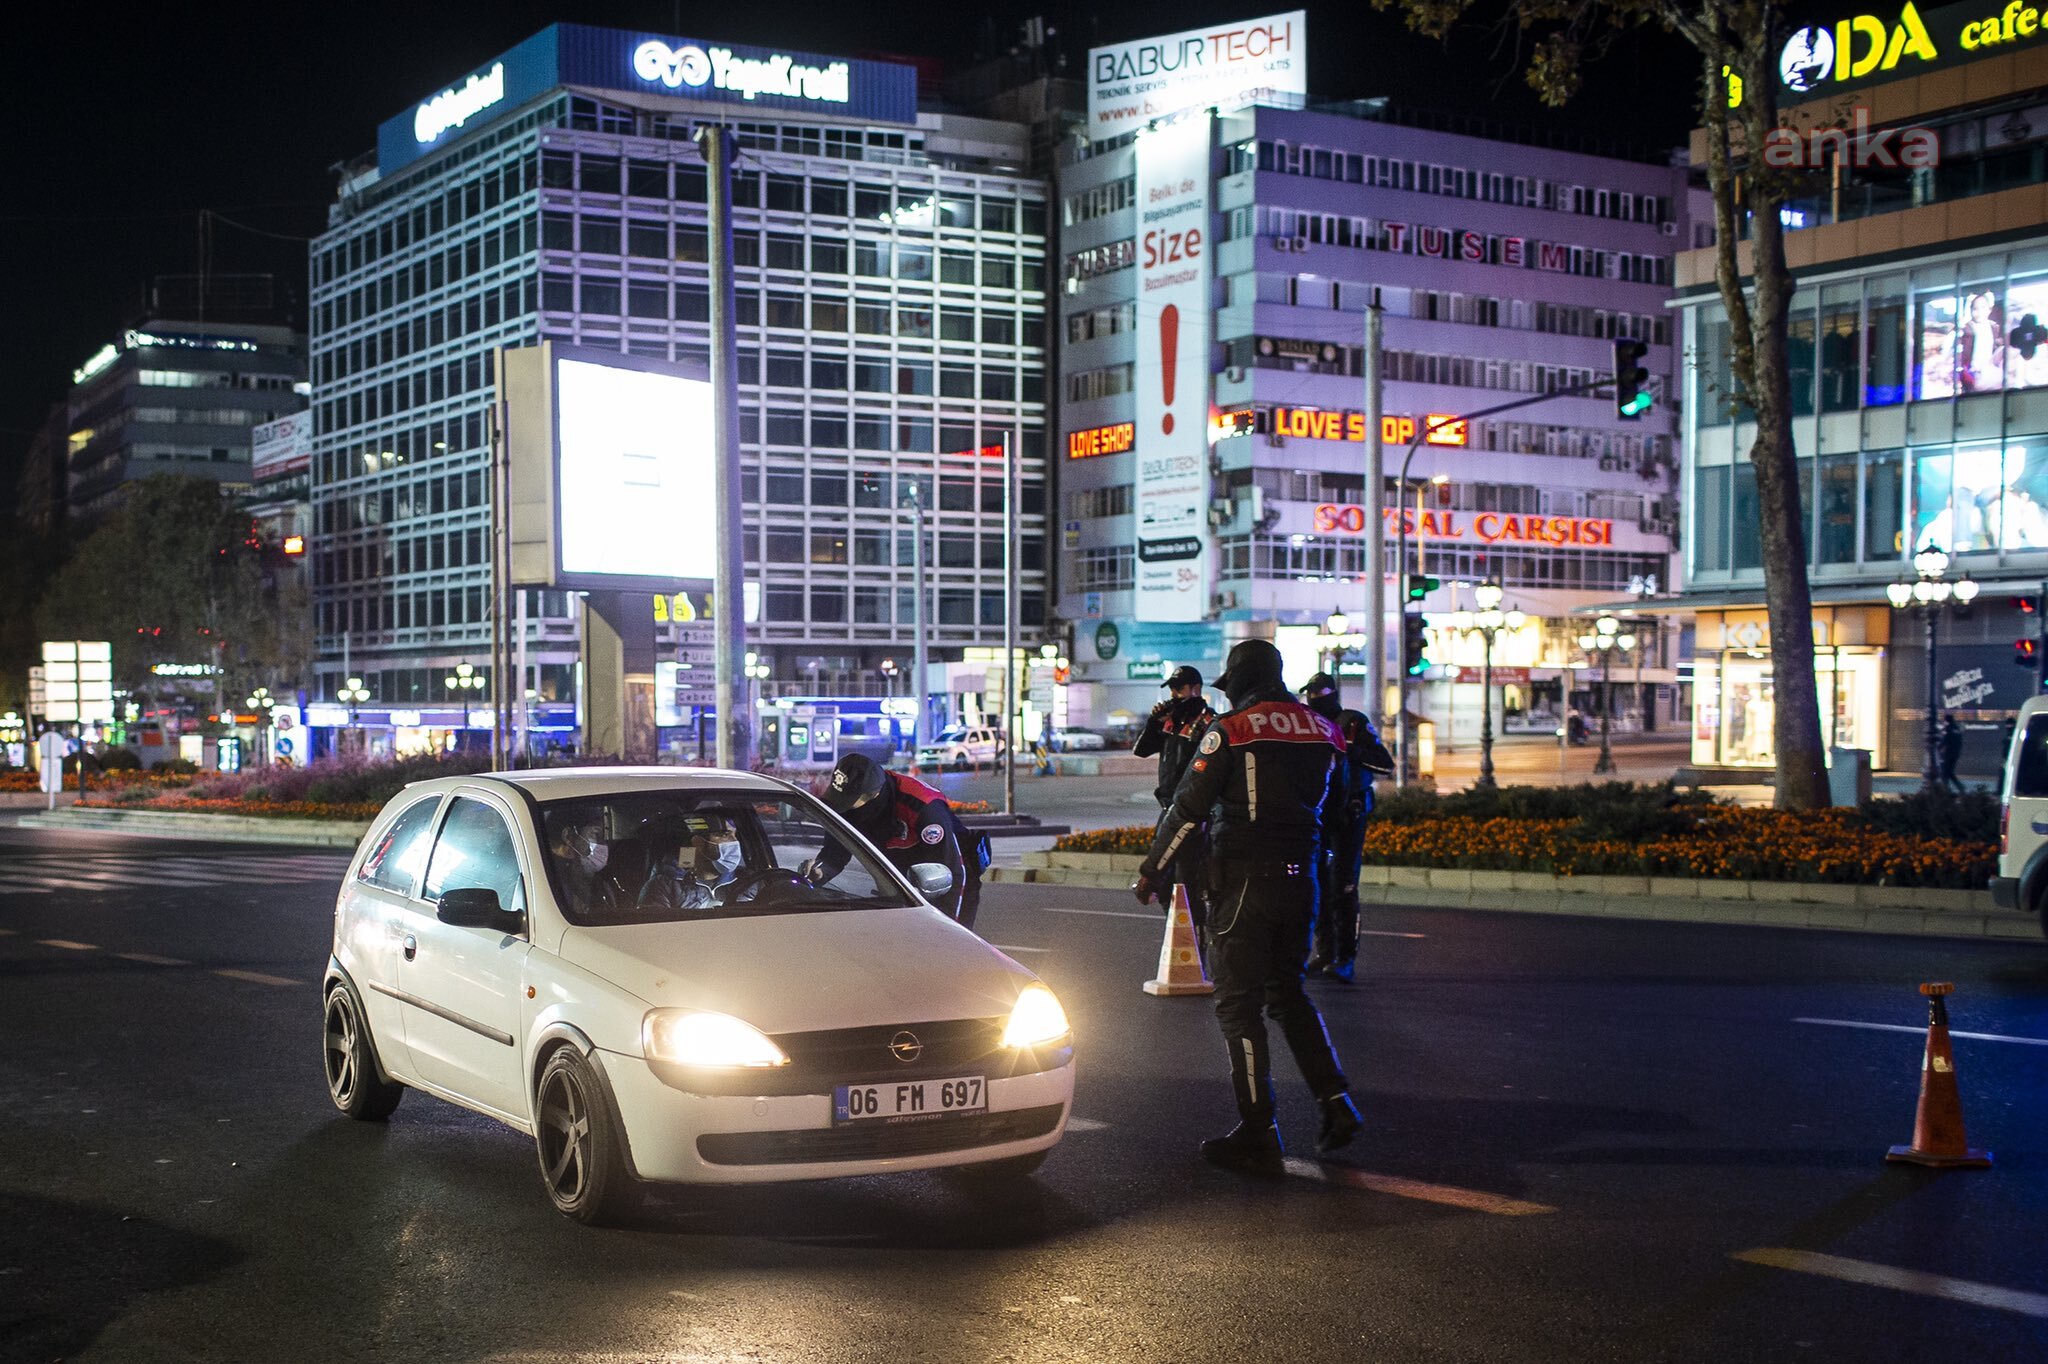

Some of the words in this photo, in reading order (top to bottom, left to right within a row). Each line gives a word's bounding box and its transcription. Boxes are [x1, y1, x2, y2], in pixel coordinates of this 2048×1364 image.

[1960, 0, 2039, 51] cafe
[1096, 21, 1291, 84] BABURTECH
[1143, 229, 1201, 269] Size
[1385, 223, 1566, 270] TUSEM
[1070, 428, 1100, 459] LOVE
[1100, 423, 1134, 454] SHOP
[1275, 408, 1342, 441] LOVE
[1347, 412, 1416, 445] SOP
[1246, 710, 1334, 738] POLİS
[837, 1106, 848, 1114] TR
[850, 1087, 878, 1116] 06
[896, 1084, 924, 1112] FM
[941, 1079, 982, 1108] 697
